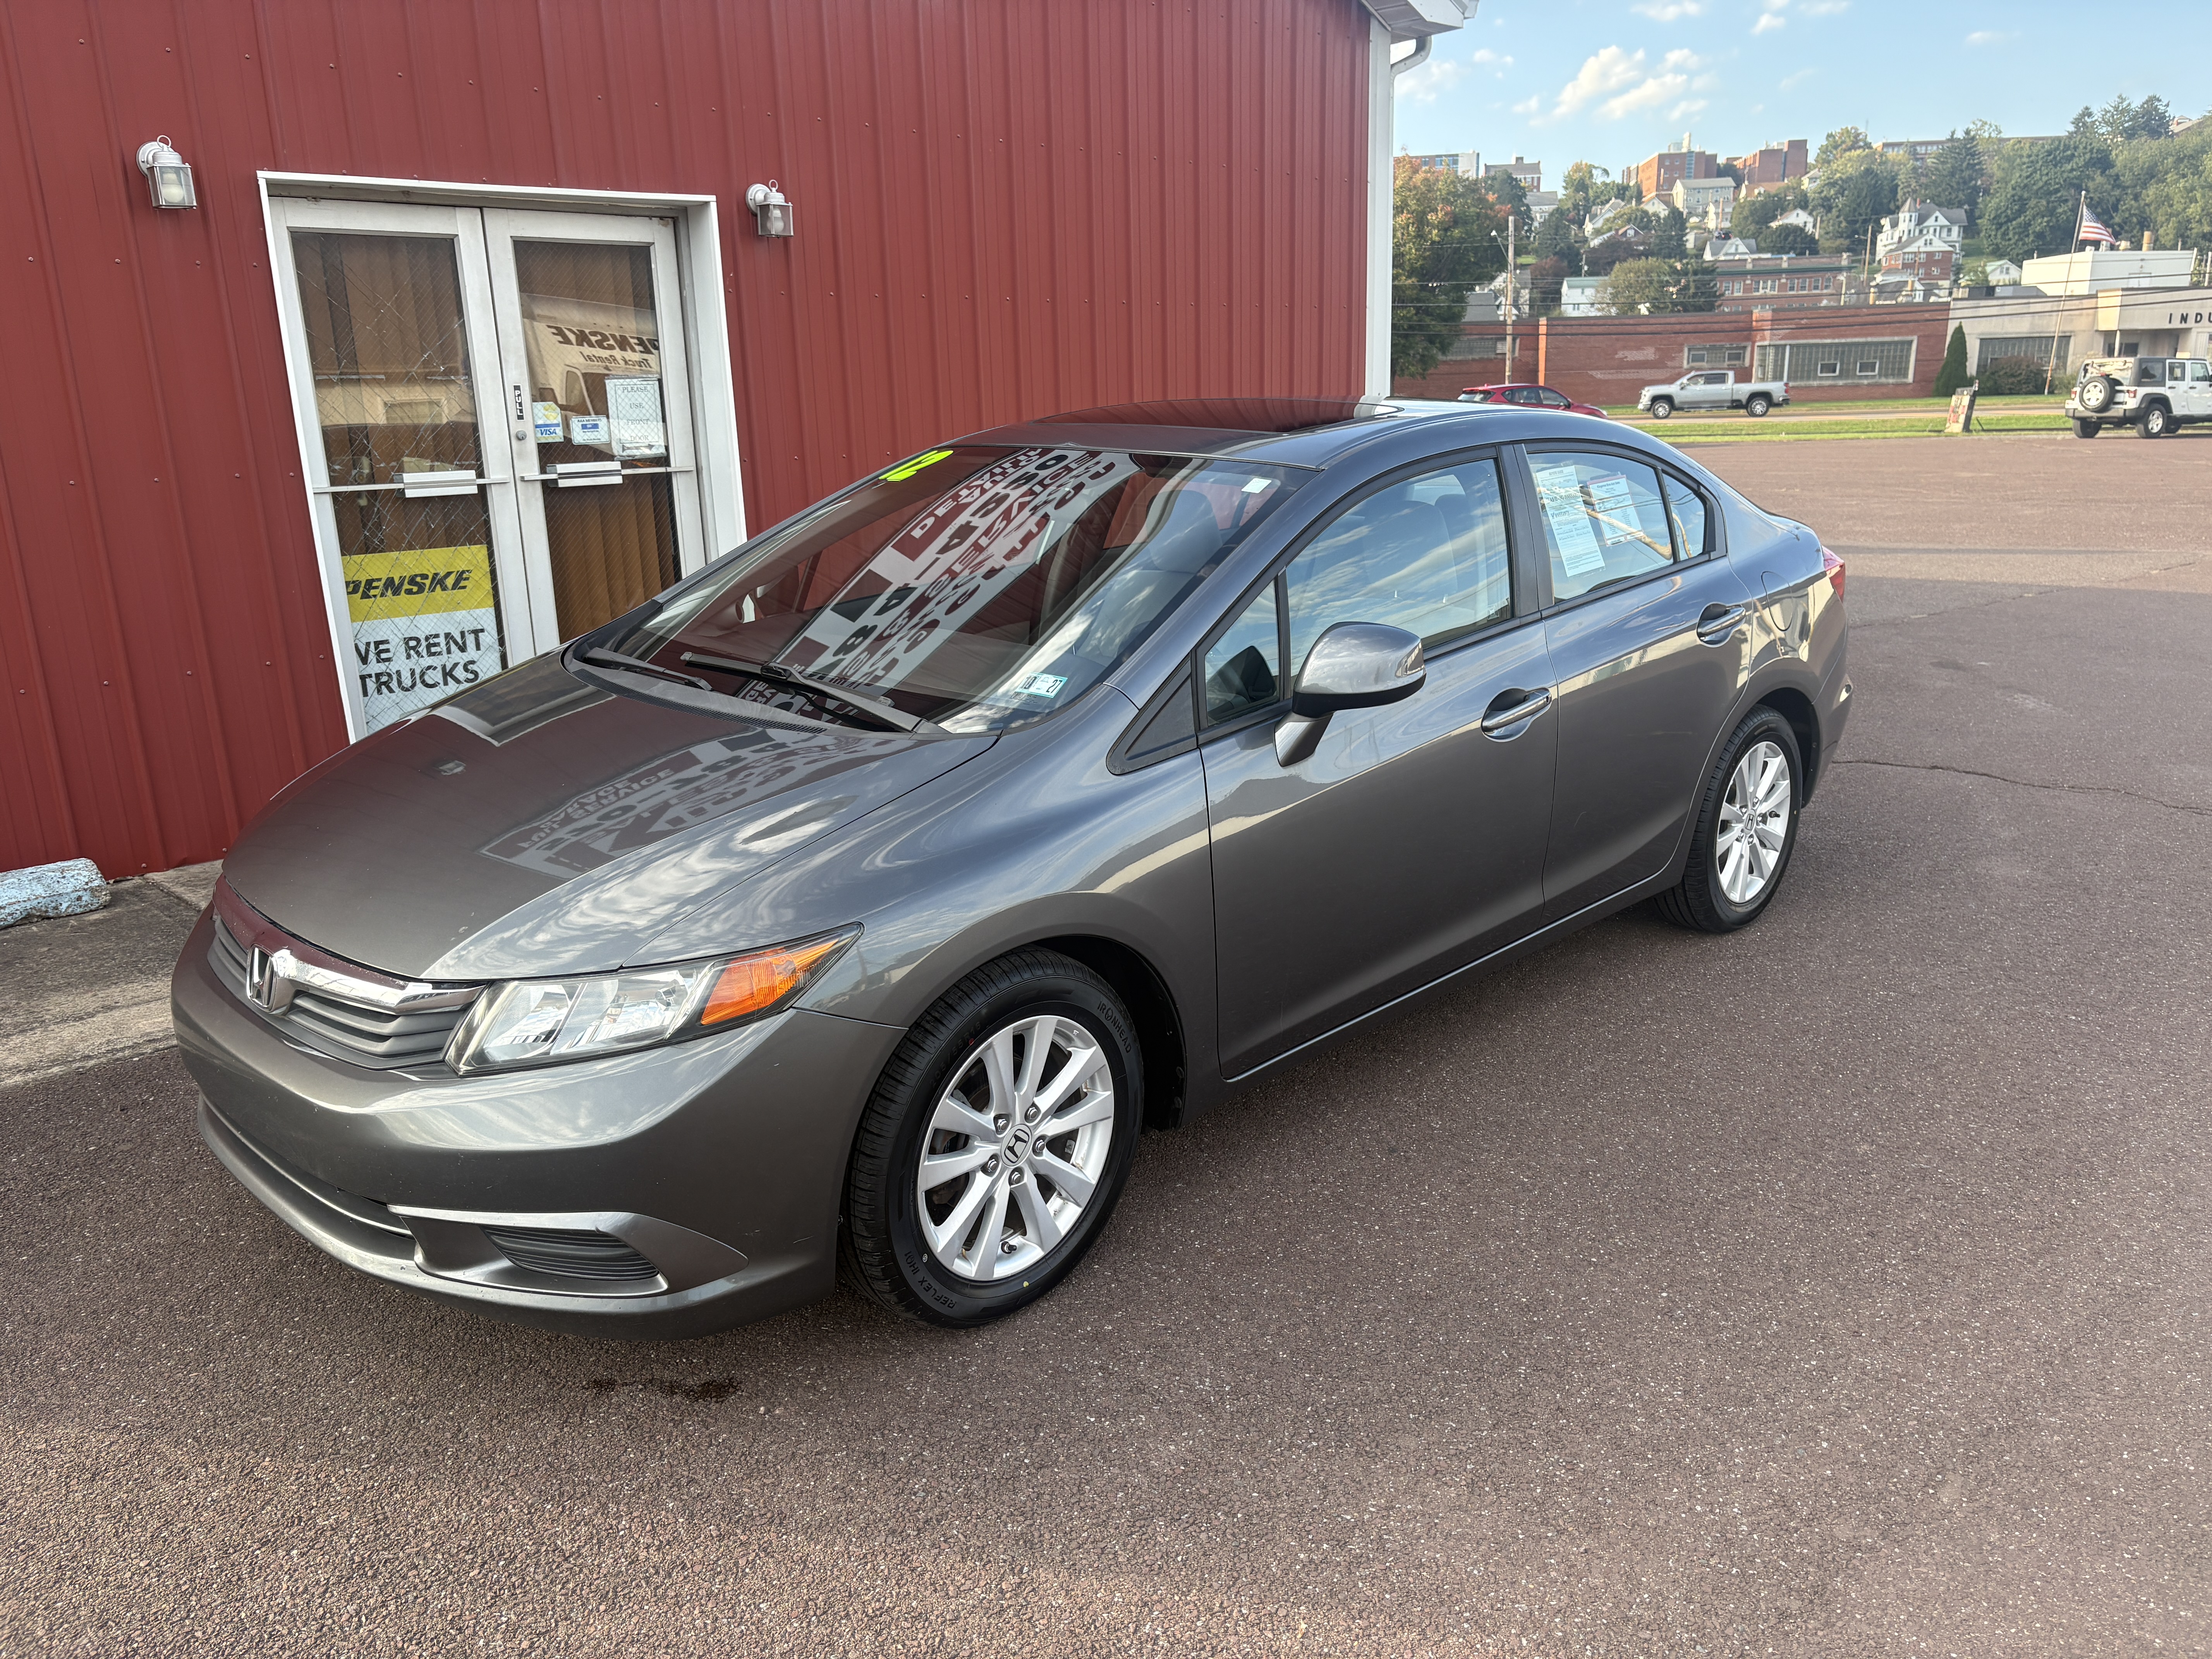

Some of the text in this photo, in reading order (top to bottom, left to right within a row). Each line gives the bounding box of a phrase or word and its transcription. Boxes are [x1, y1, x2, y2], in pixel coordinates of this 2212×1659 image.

[515, 390, 523, 416] PULL
[345, 570, 473, 599] PENSKE
[404, 629, 485, 660] RENT
[359, 660, 479, 697] TRUCKS
[1046, 679, 1063, 693] 27
[1097, 1001, 1132, 1053] IRONHEAD
[918, 1276, 957, 1309] REFLEX
